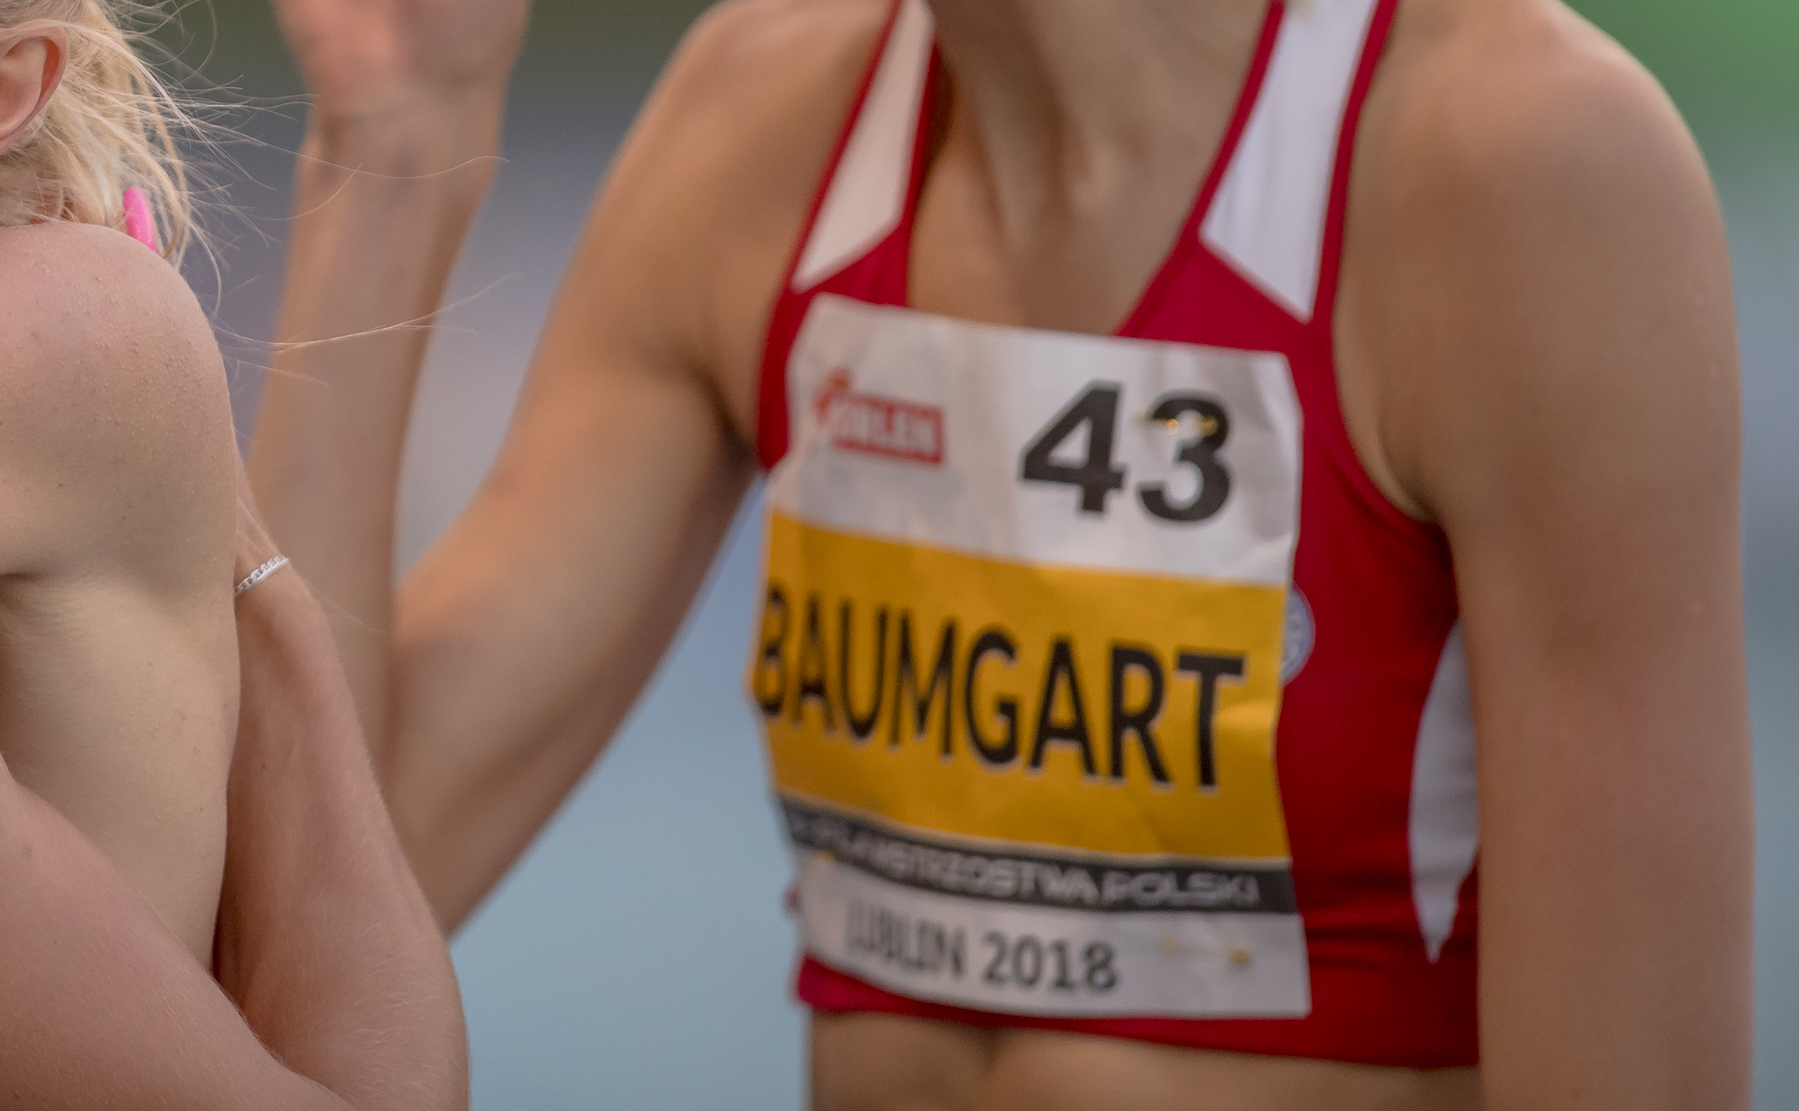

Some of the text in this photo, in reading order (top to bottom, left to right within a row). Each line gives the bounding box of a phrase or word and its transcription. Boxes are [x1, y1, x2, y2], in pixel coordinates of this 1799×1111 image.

[1020, 379, 1234, 525] 43
[753, 581, 1246, 788] BAUMGART
[980, 930, 1120, 992] 2018
